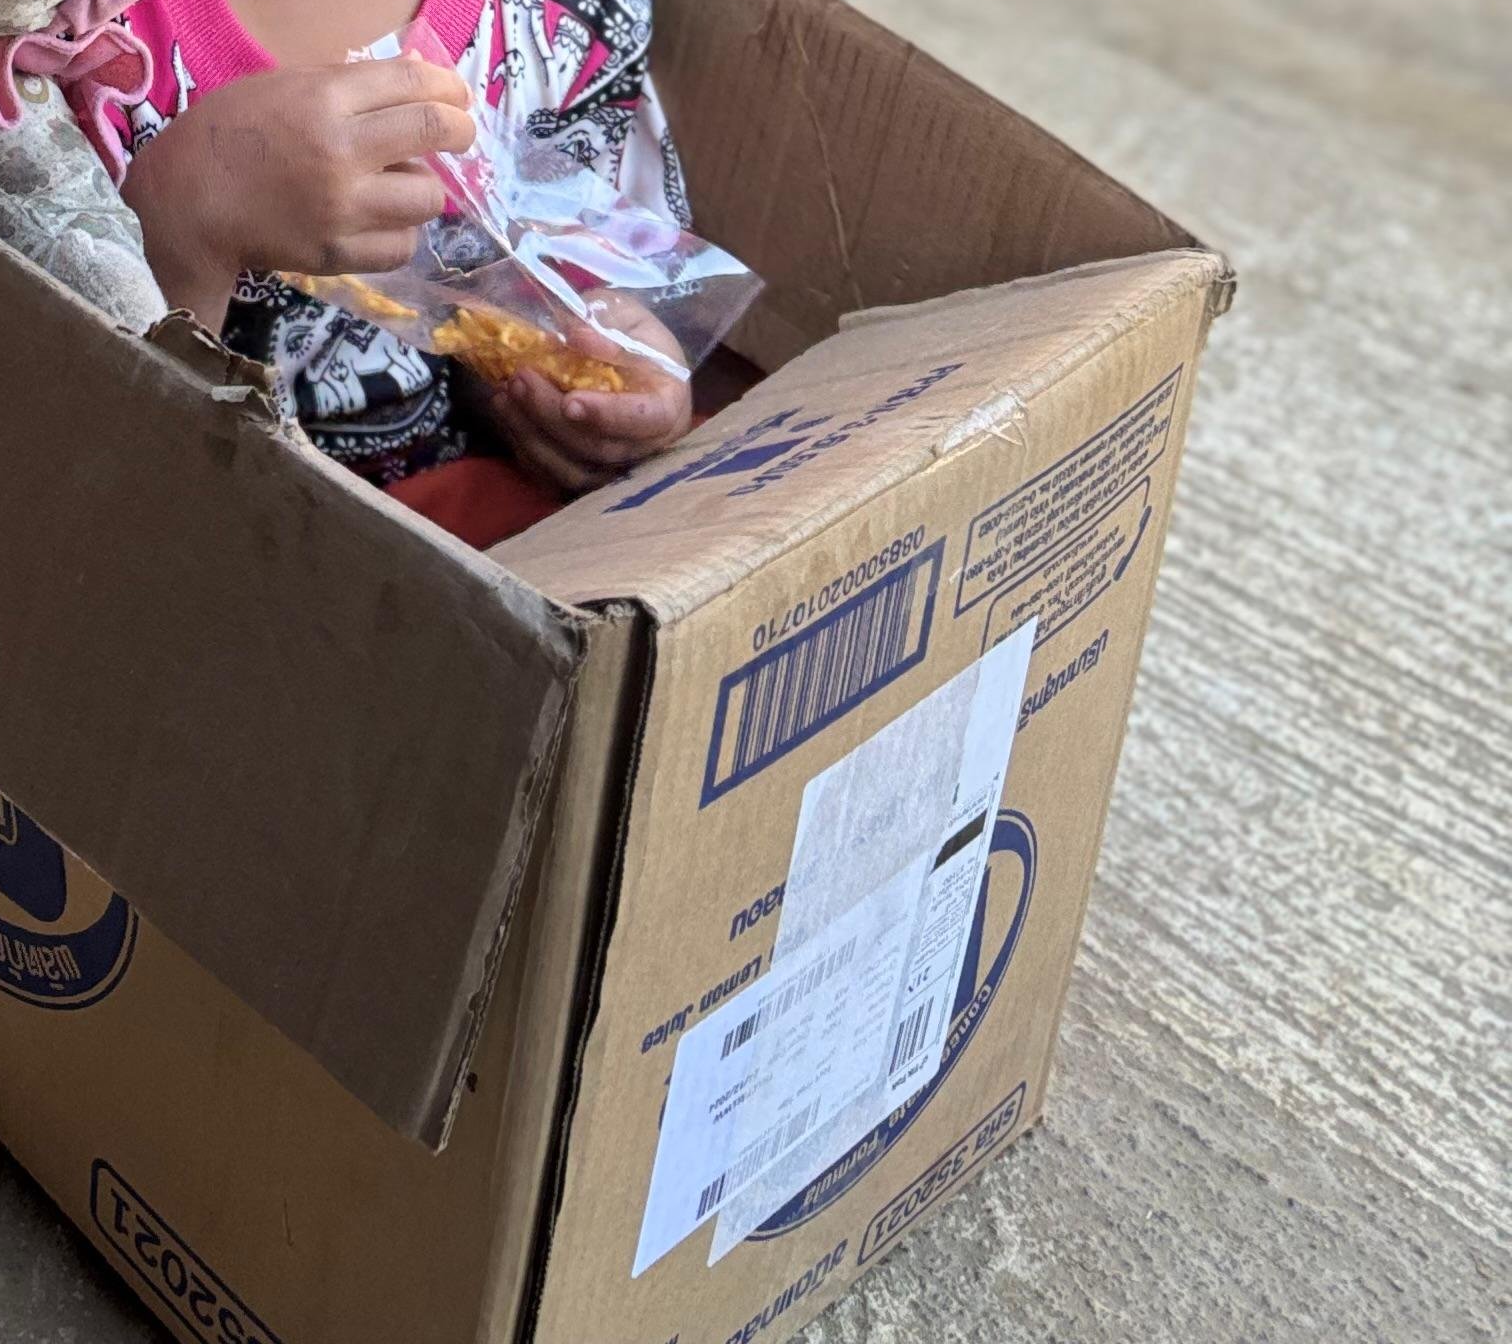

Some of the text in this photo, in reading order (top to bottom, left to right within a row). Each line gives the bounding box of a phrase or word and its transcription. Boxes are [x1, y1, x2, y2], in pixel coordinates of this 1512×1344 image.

[753, 524, 925, 652] 08850002010710
[641, 955, 763, 1054] Lemon Juice
[802, 1130, 881, 1206] Formula
[875, 1143, 969, 1238] 352021
[110, 1188, 264, 1344] 52021
